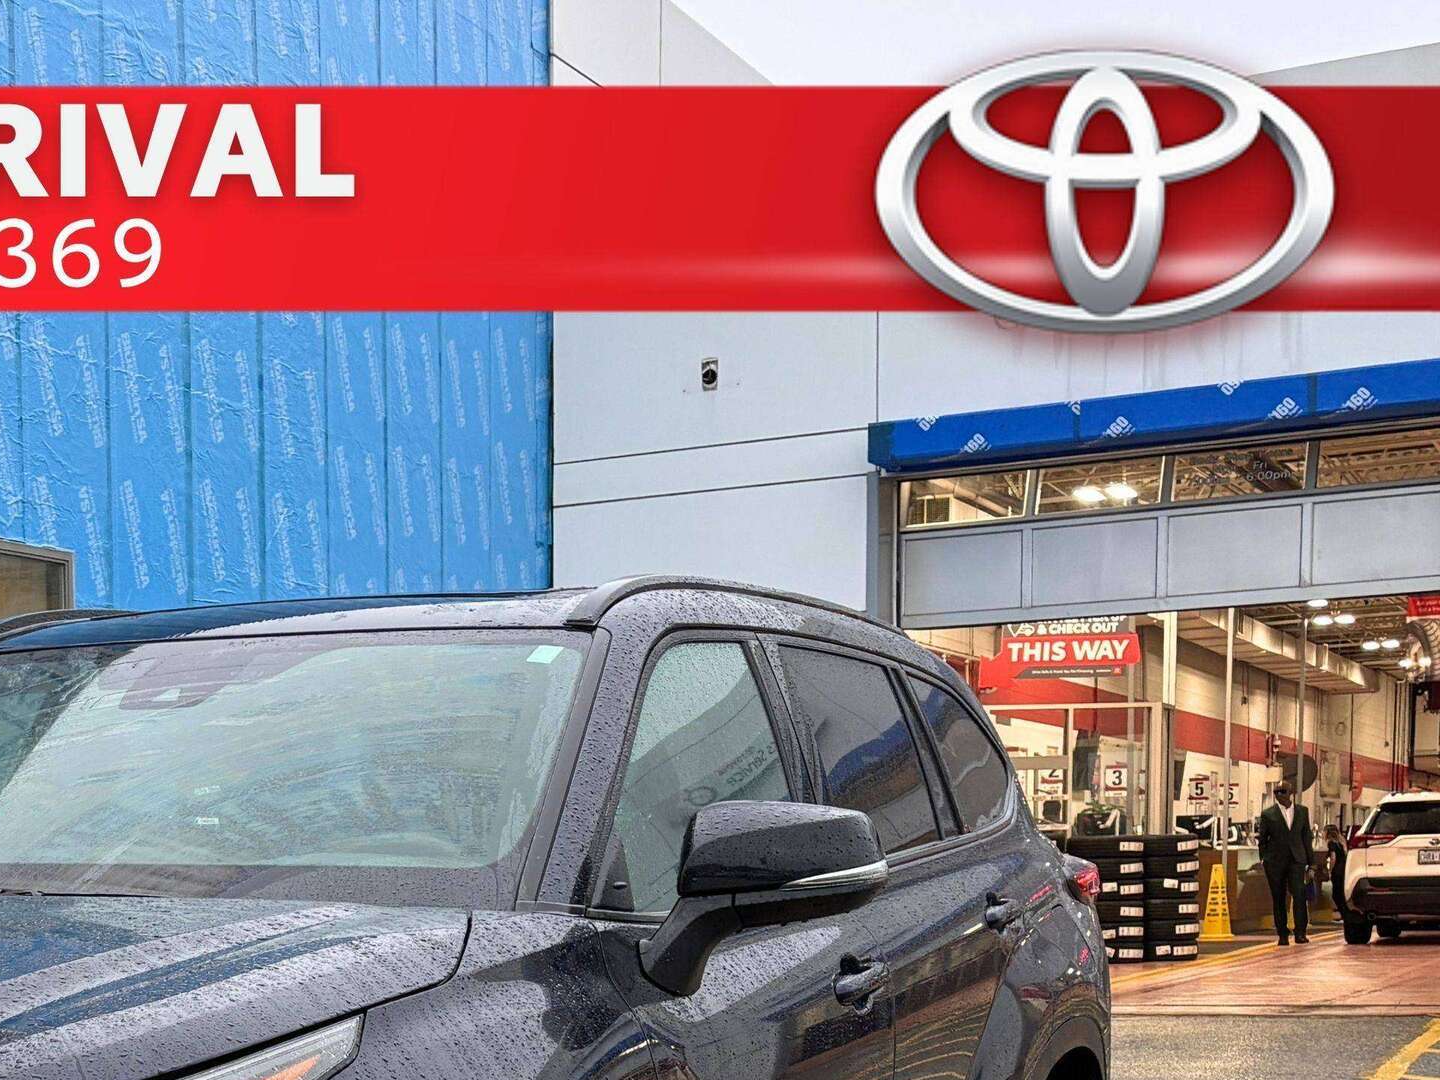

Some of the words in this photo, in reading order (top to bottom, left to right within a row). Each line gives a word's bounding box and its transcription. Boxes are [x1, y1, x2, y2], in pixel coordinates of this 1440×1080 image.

[1048, 622, 1091, 635] CHECK
[1091, 621, 1119, 634] OUT
[1007, 641, 1067, 662] THIS
[1071, 639, 1130, 661] WAY
[1112, 769, 1123, 786] 3
[1194, 781, 1204, 796] 5
